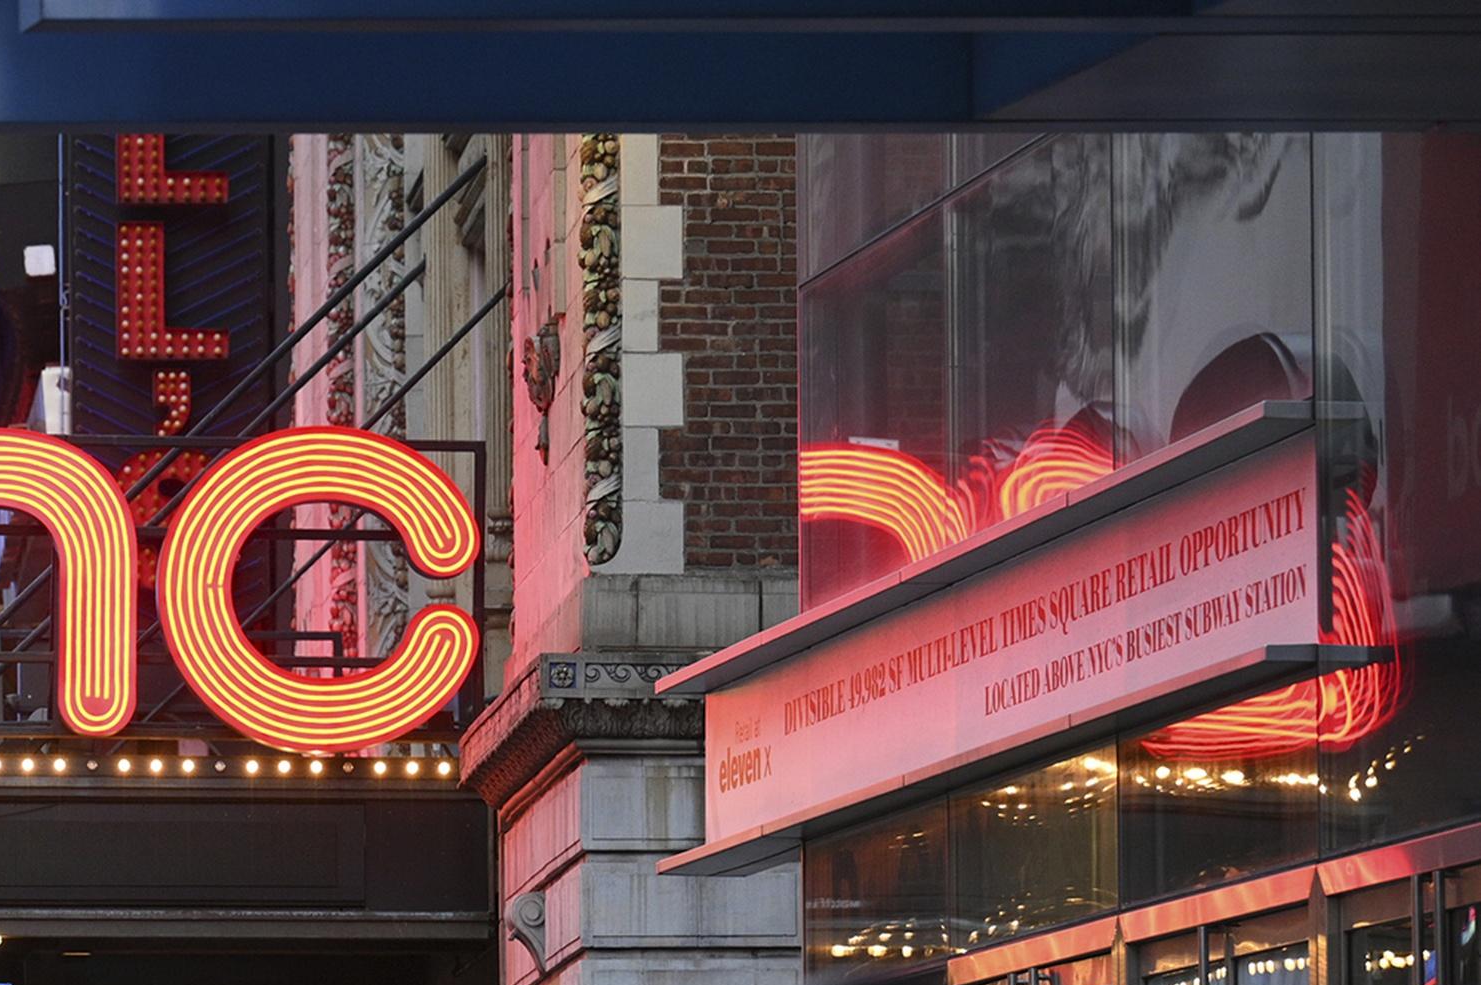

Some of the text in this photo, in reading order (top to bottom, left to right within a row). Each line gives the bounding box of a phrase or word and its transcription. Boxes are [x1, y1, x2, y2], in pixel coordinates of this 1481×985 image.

[784, 679, 846, 736] DIVISIBLE
[888, 654, 905, 694] SF
[906, 616, 998, 688] MULTI-LEVEL
[1000, 596, 1047, 649] TIMES
[1049, 568, 1112, 635] SQUARE
[1115, 542, 1175, 604] RETAIL
[1179, 487, 1307, 577] OPPORTUNITY
[984, 667, 1040, 716] LOCATED
[1041, 650, 1085, 695] ABOVE
[1126, 611, 1183, 663] BUSIEST
[1184, 587, 1242, 641] SUBWAY
[1245, 563, 1307, 620] STATION
[719, 747, 761, 794] eleven
